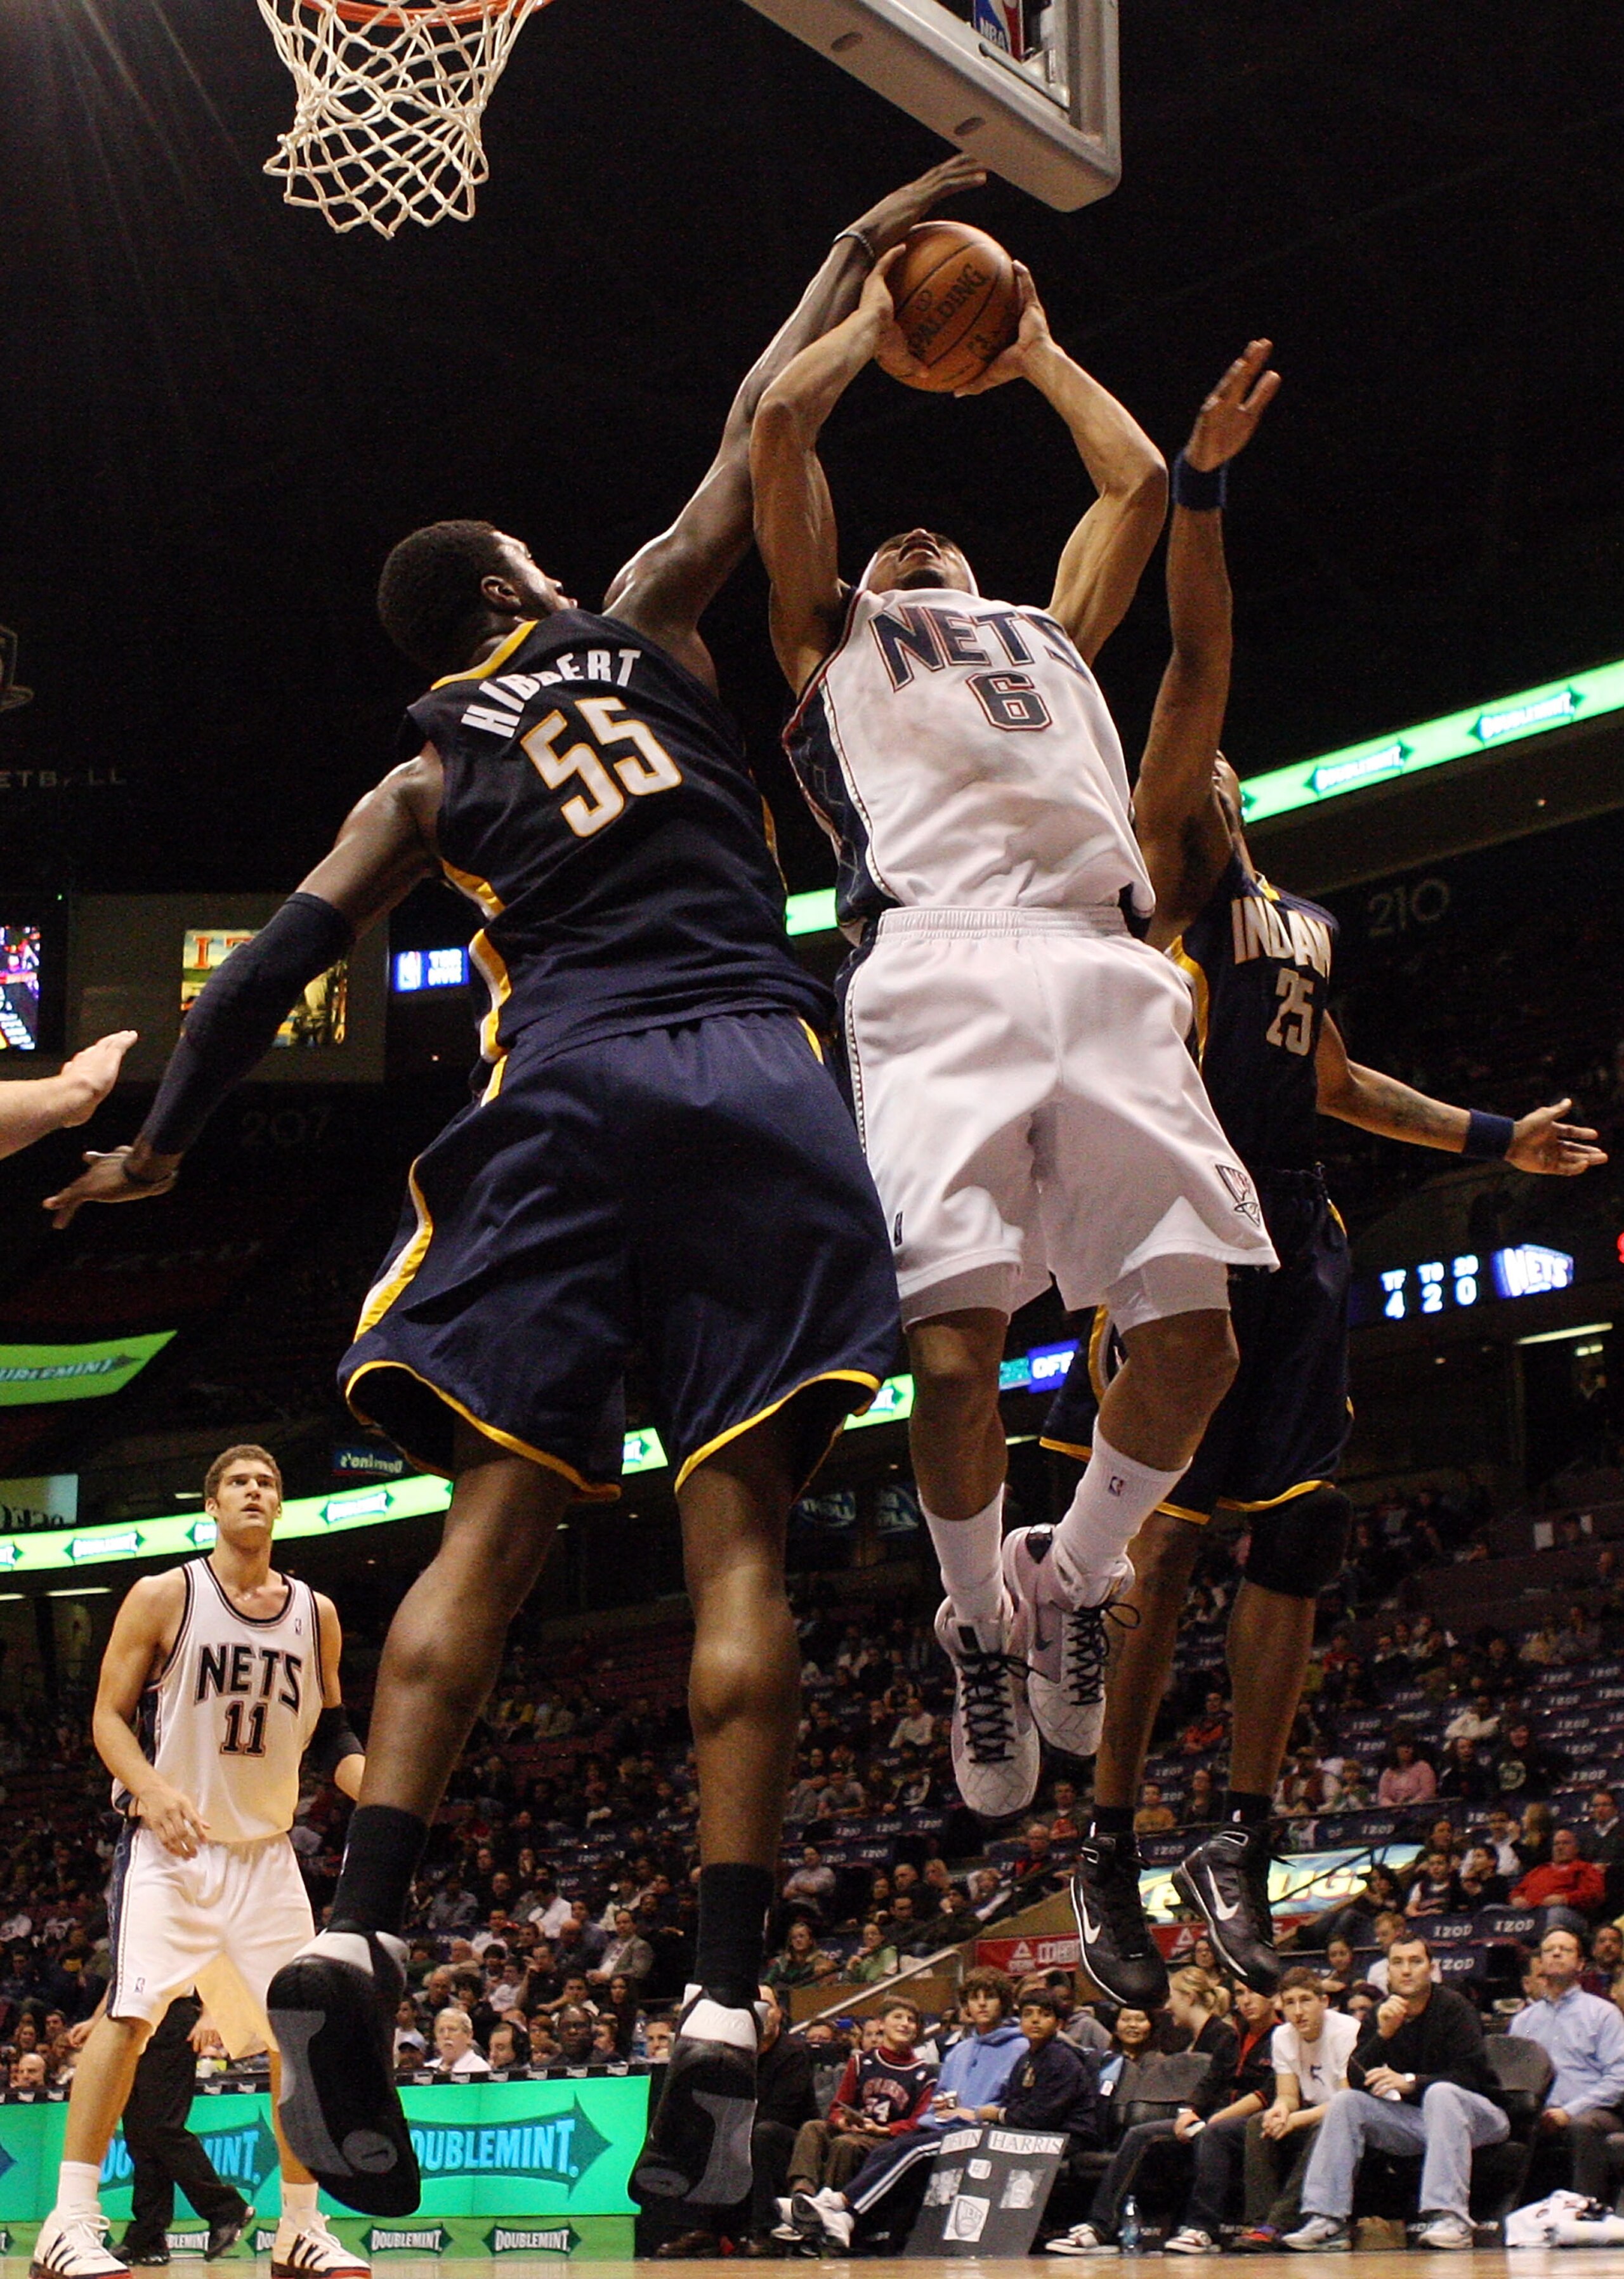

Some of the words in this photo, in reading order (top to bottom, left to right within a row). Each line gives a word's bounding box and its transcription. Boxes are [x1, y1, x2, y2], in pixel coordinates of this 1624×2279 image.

[461, 648, 642, 738] HIBBERT
[966, 669, 1053, 731] 6
[520, 697, 683, 837] 55
[1266, 966, 1315, 1056] 25
[1421, 1283, 1443, 1313] 2
[1455, 1276, 1477, 1306] 0
[1502, 1247, 1569, 1297] NETS
[194, 1643, 302, 1717] NETS
[220, 1700, 268, 1757] 11
[1434, 1924, 1474, 1938] IZOD
[1494, 1919, 1535, 1933] IZOD
[992, 2134, 1061, 2152] HARRIS
